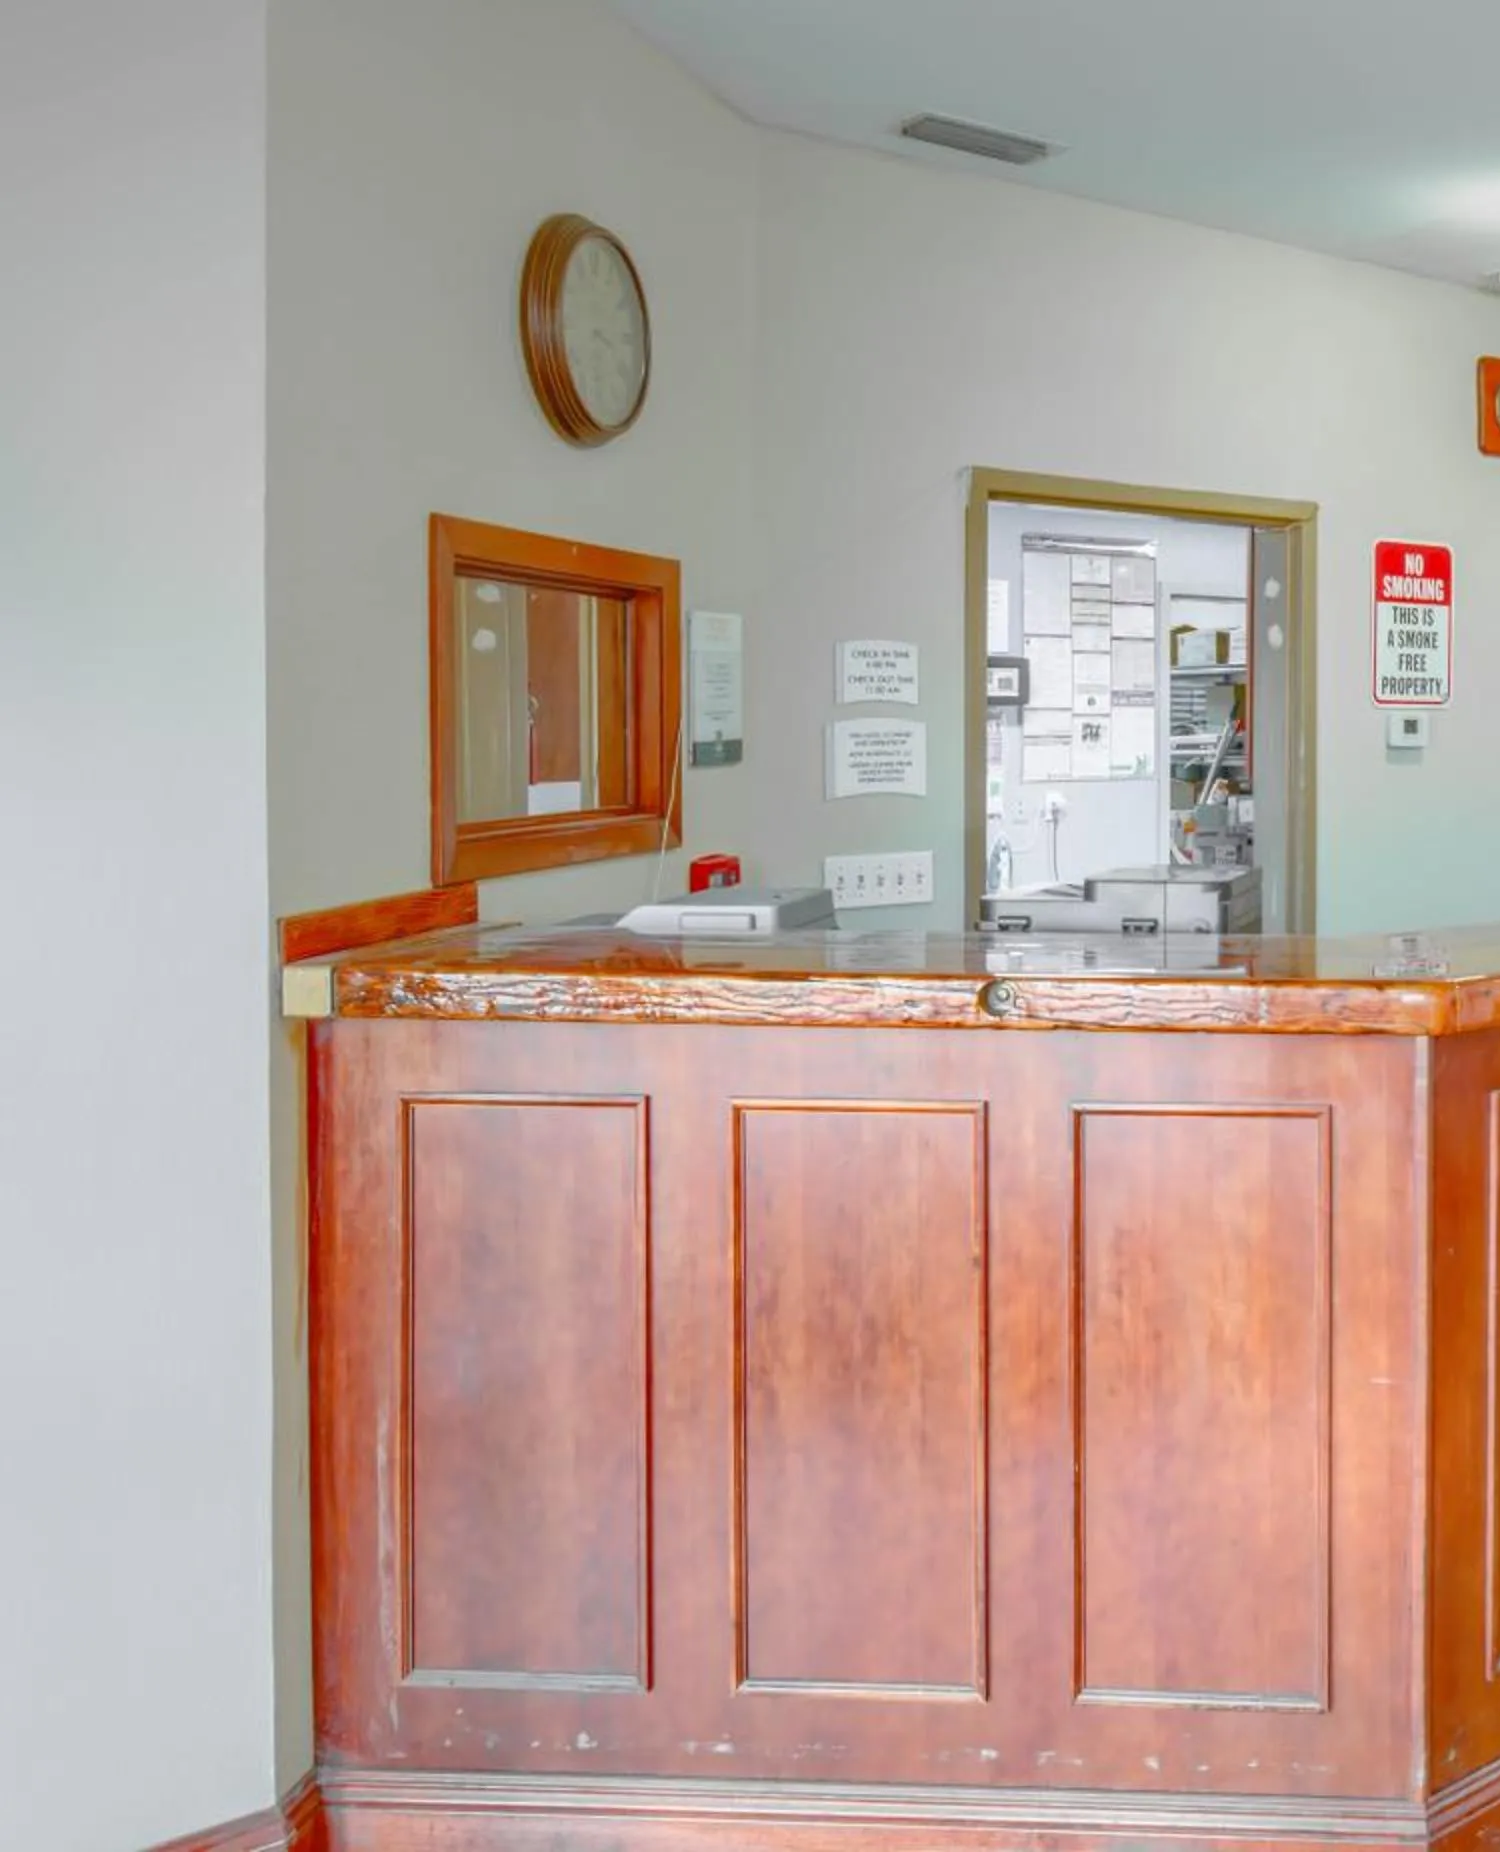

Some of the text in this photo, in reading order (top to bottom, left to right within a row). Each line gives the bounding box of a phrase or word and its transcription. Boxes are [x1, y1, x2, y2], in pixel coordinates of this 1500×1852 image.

[1404, 552, 1425, 576] NO
[1382, 574, 1445, 601] SMOKING
[1391, 606, 1435, 627] THIS IS
[1387, 630, 1439, 650] A SMOKE
[850, 649, 878, 659] CHECK
[1398, 653, 1427, 673] FREE
[847, 674, 875, 684] CHECK
[1380, 676, 1443, 697] PROPERTY
